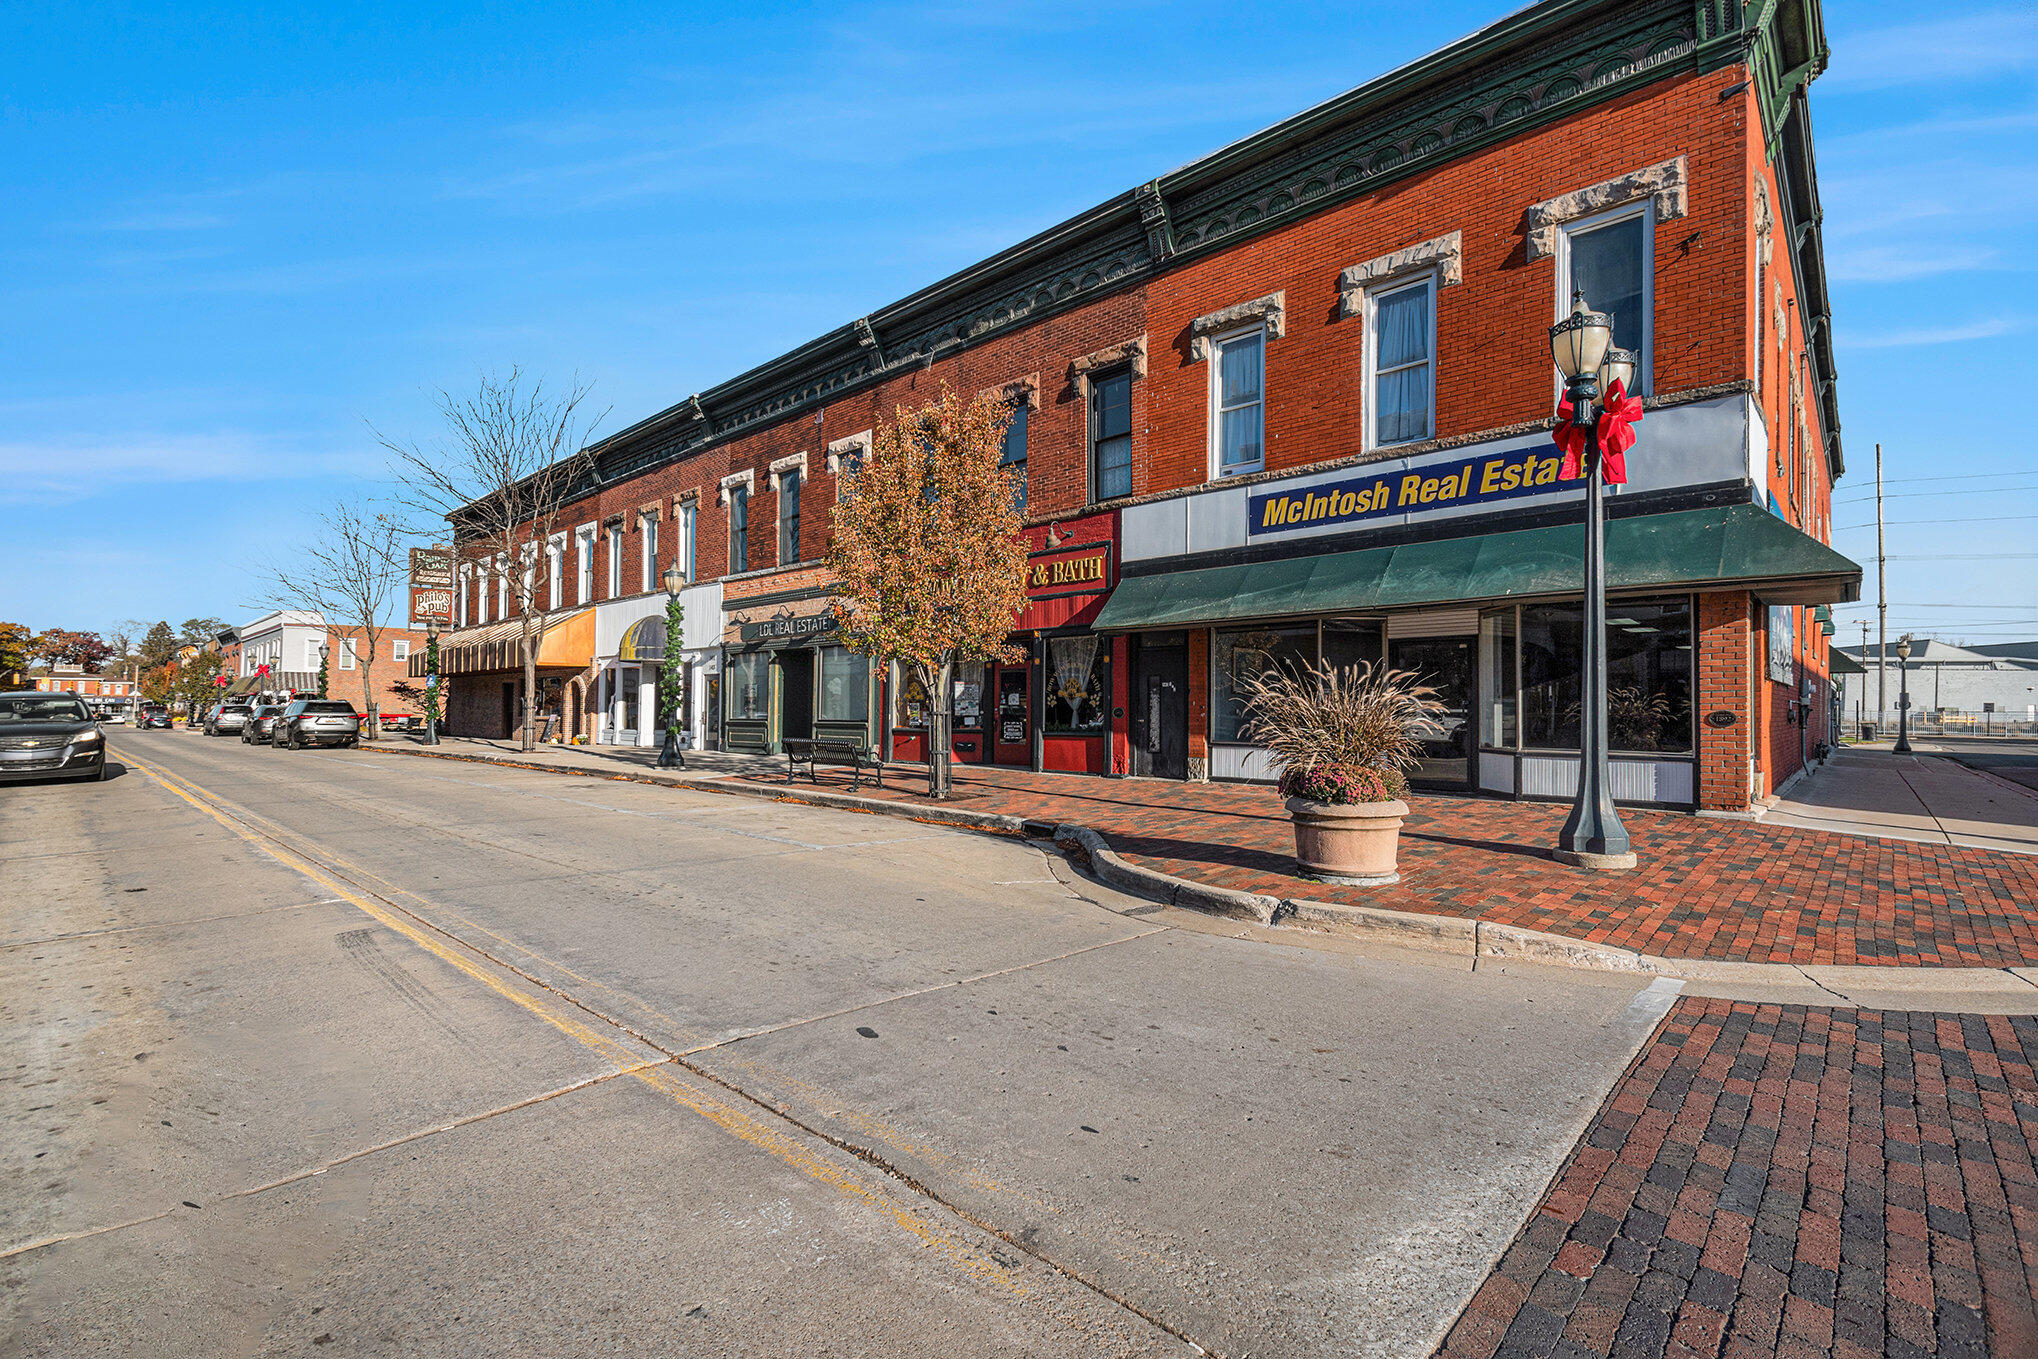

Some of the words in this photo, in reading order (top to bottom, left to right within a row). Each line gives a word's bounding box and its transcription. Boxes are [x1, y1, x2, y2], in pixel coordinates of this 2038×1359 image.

[1261, 479, 1391, 528] McIntosh
[1397, 464, 1473, 508] Real
[1479, 453, 1588, 495] Esta
[1032, 563, 1049, 586] &
[1051, 555, 1104, 584] BATH
[759, 624, 773, 637] LDL
[775, 621, 795, 635] REAL
[797, 616, 828, 632] ESTATE
